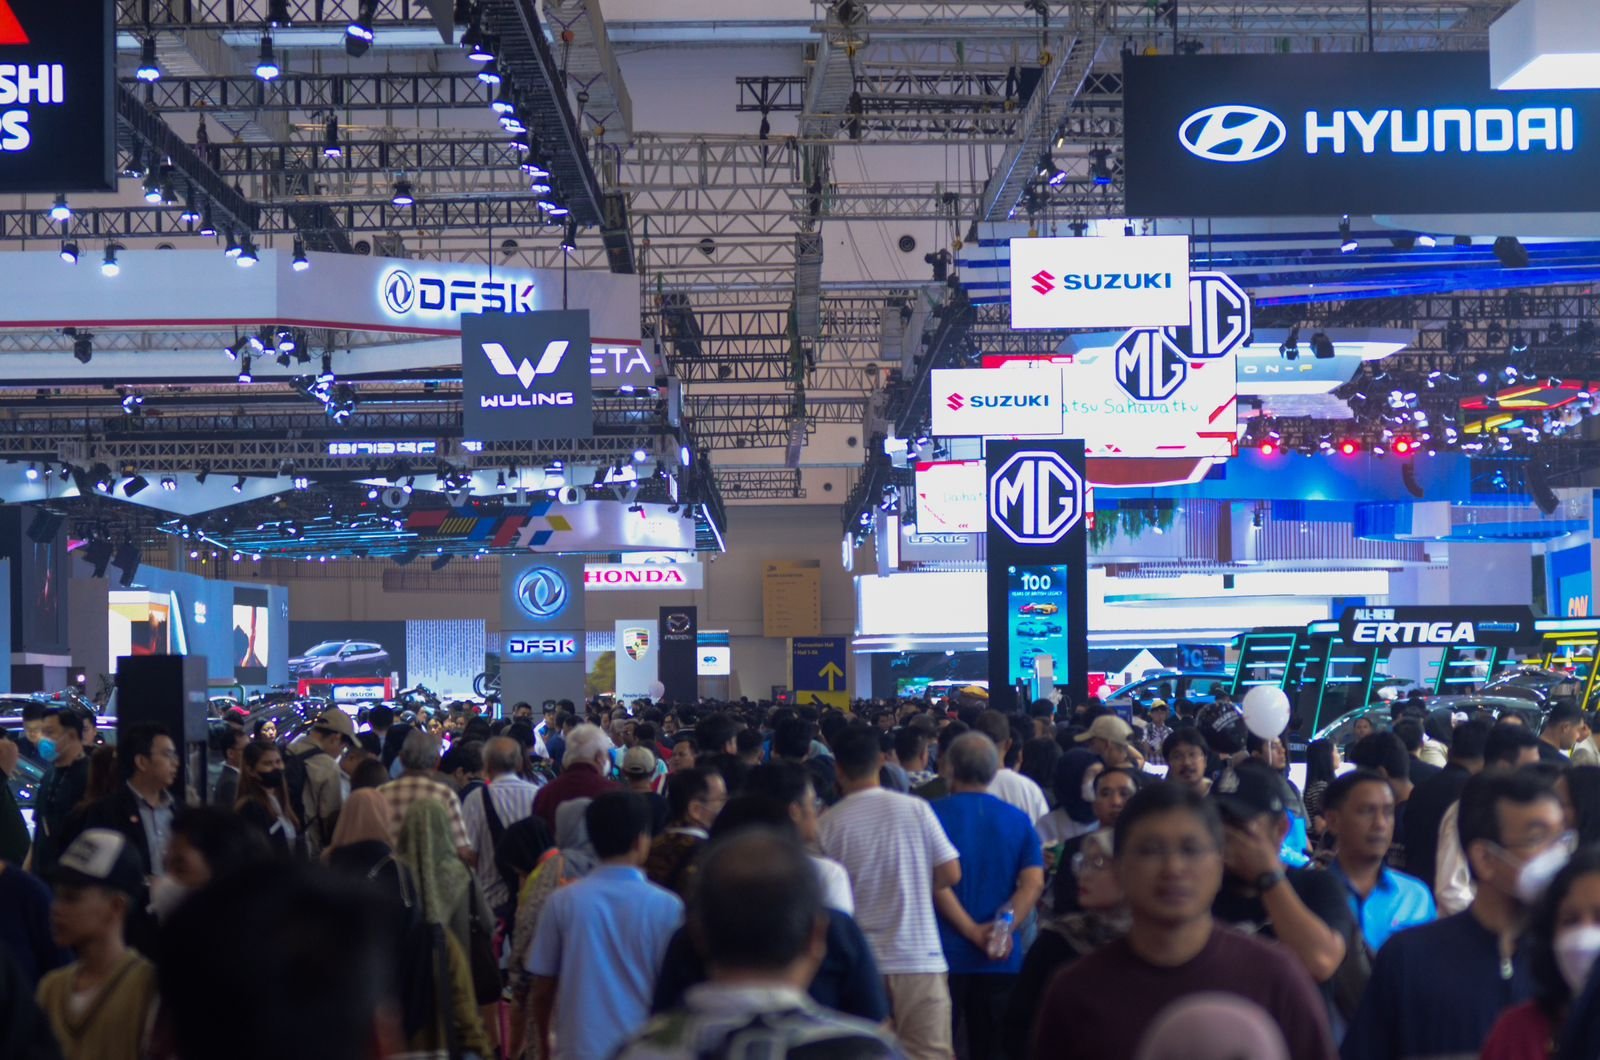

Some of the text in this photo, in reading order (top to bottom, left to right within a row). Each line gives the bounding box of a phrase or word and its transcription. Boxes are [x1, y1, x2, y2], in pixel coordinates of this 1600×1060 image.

[0, 110, 30, 150] S
[1305, 106, 1574, 154] HYUNDAI
[1063, 273, 1172, 290] SUZUKI
[419, 277, 534, 312] DFSK
[480, 391, 573, 408] WULING
[970, 395, 1049, 407] SUZUKI
[999, 460, 1074, 535] MG
[908, 535, 969, 544] LEXUS
[584, 570, 685, 583] HONDA
[1021, 574, 1052, 590] 100
[1352, 622, 1475, 643] ERTIGA
[510, 640, 576, 654] DFSK
